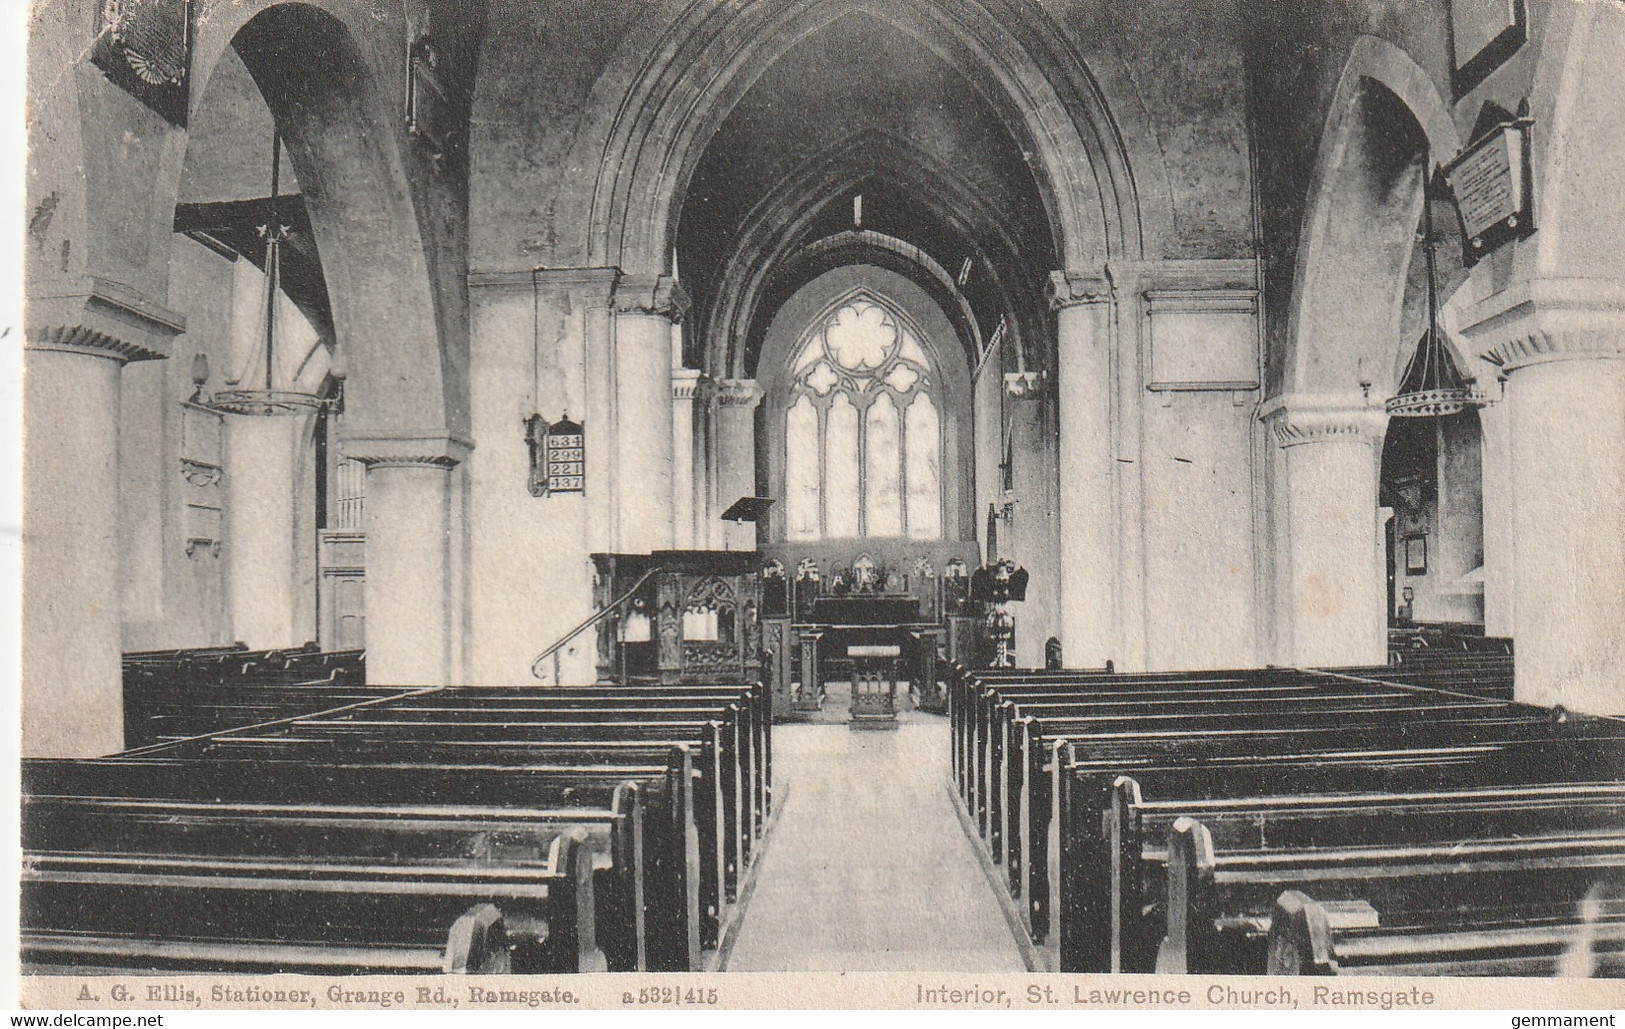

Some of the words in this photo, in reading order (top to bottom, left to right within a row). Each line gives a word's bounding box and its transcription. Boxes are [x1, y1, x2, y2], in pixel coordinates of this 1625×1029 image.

[551, 436, 581, 446] 634
[551, 450, 580, 460] 299
[551, 464, 580, 474] 221
[551, 478, 581, 487] 437
